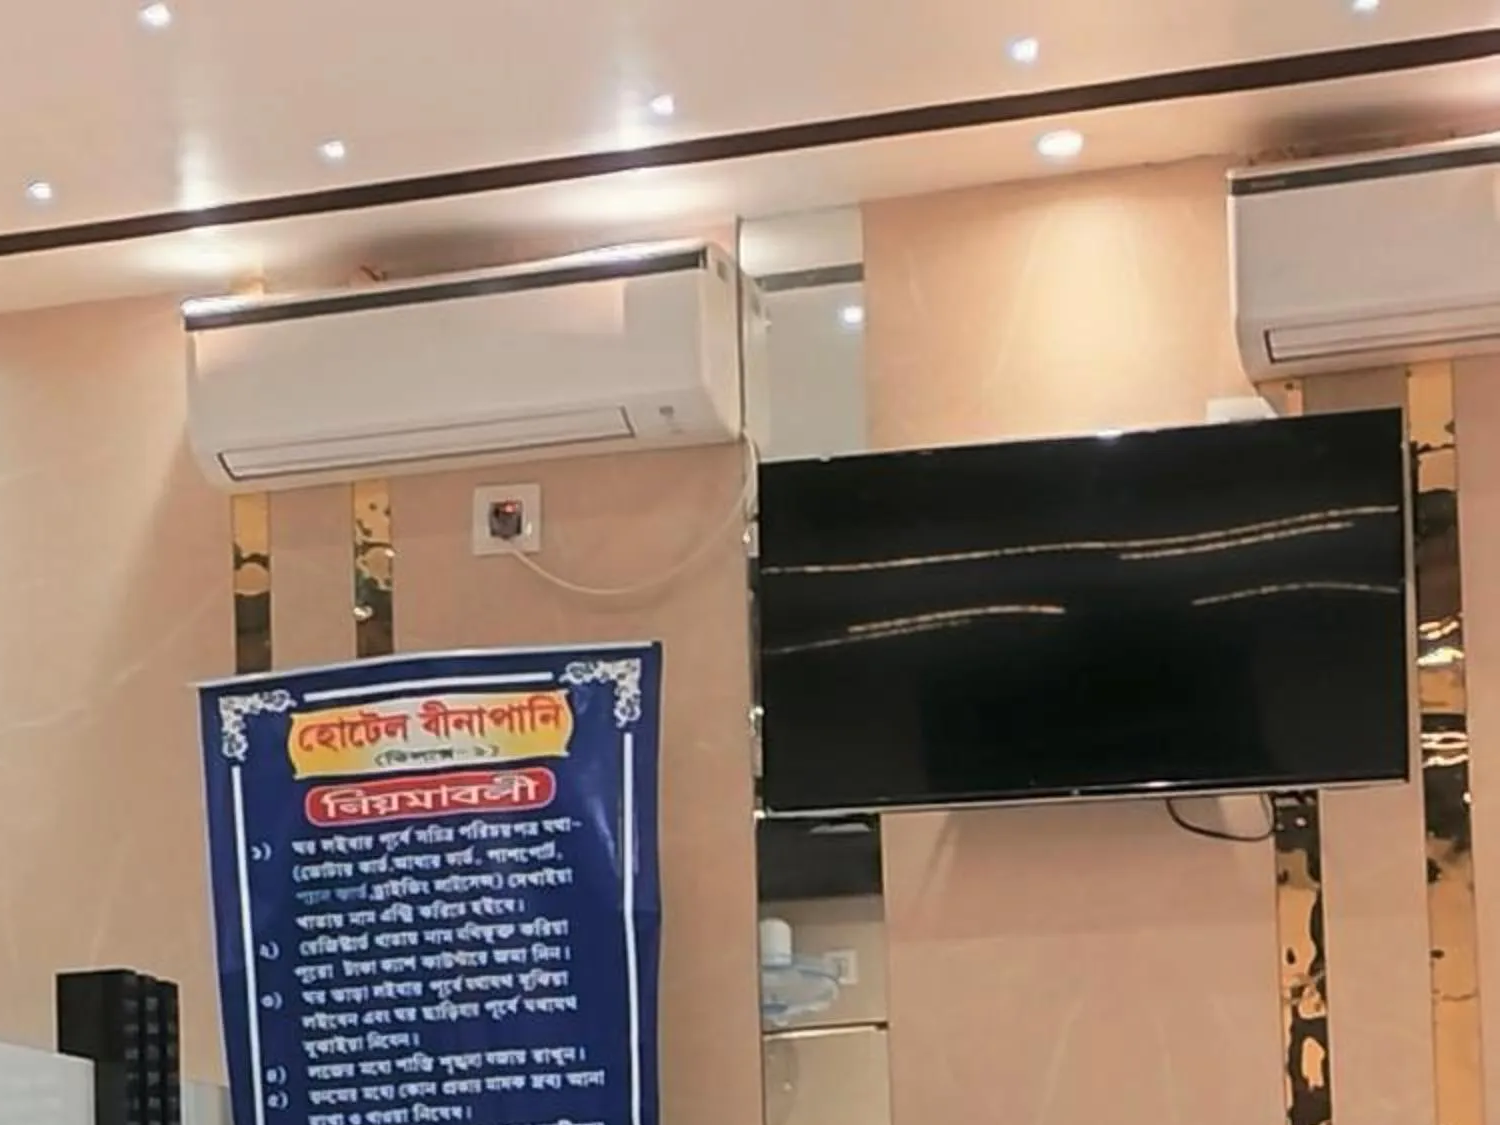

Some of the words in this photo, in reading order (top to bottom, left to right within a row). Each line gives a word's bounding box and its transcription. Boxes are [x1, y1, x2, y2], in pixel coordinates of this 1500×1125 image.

[299, 712, 409, 751] হোটেল
[417, 695, 562, 739] বীনাপানি
[321, 773, 540, 818] নিয়মাবলী
